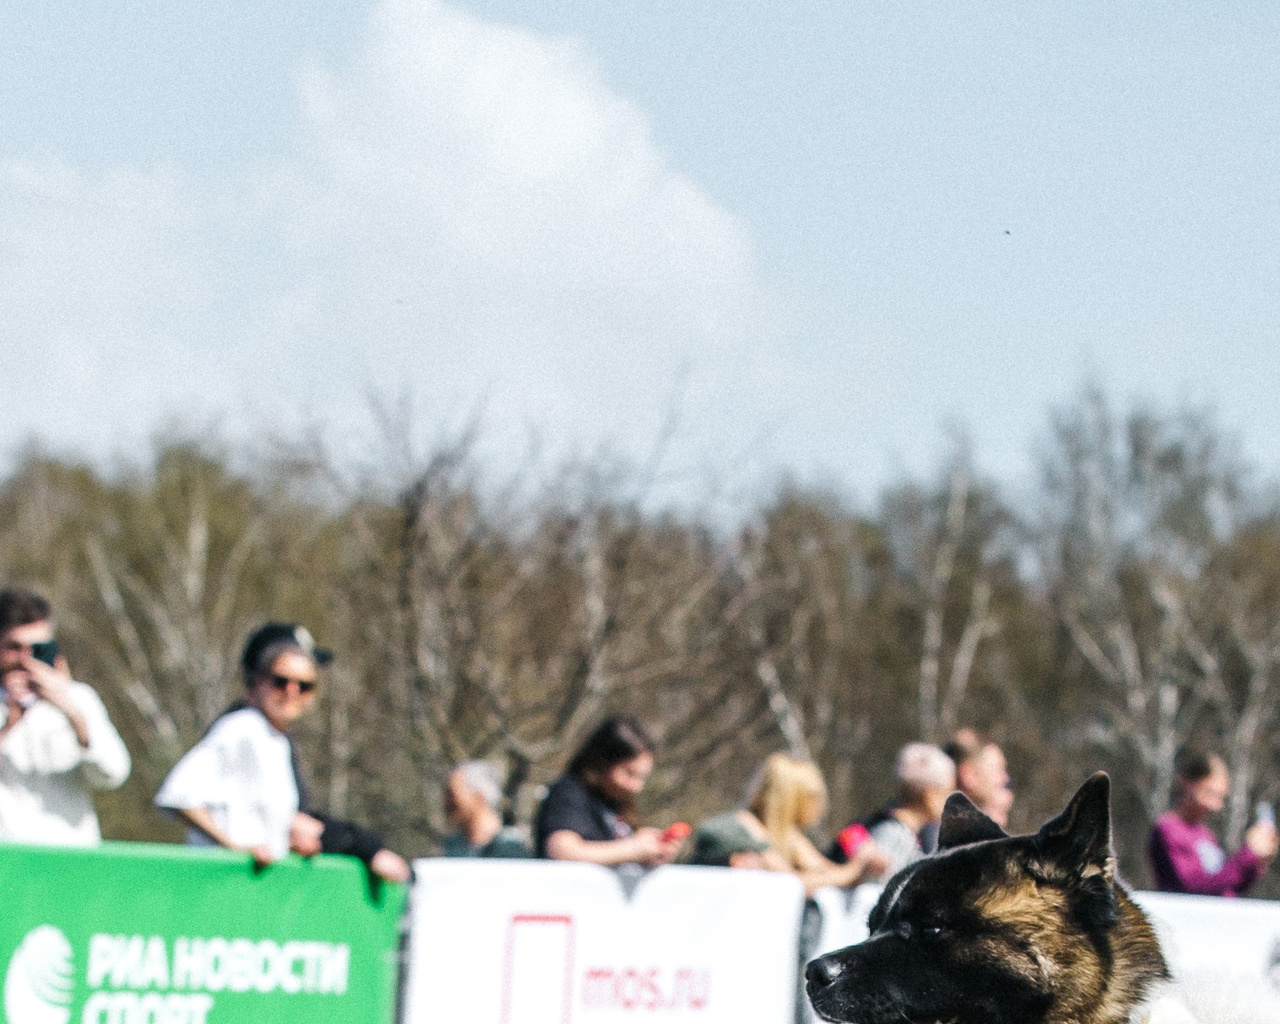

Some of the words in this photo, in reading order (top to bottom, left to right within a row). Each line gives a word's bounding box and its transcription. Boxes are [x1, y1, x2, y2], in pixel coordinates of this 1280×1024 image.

[86, 933, 169, 988] РИА
[172, 936, 350, 995] НОВОСТИ
[582, 967, 712, 1010] mos.ru
